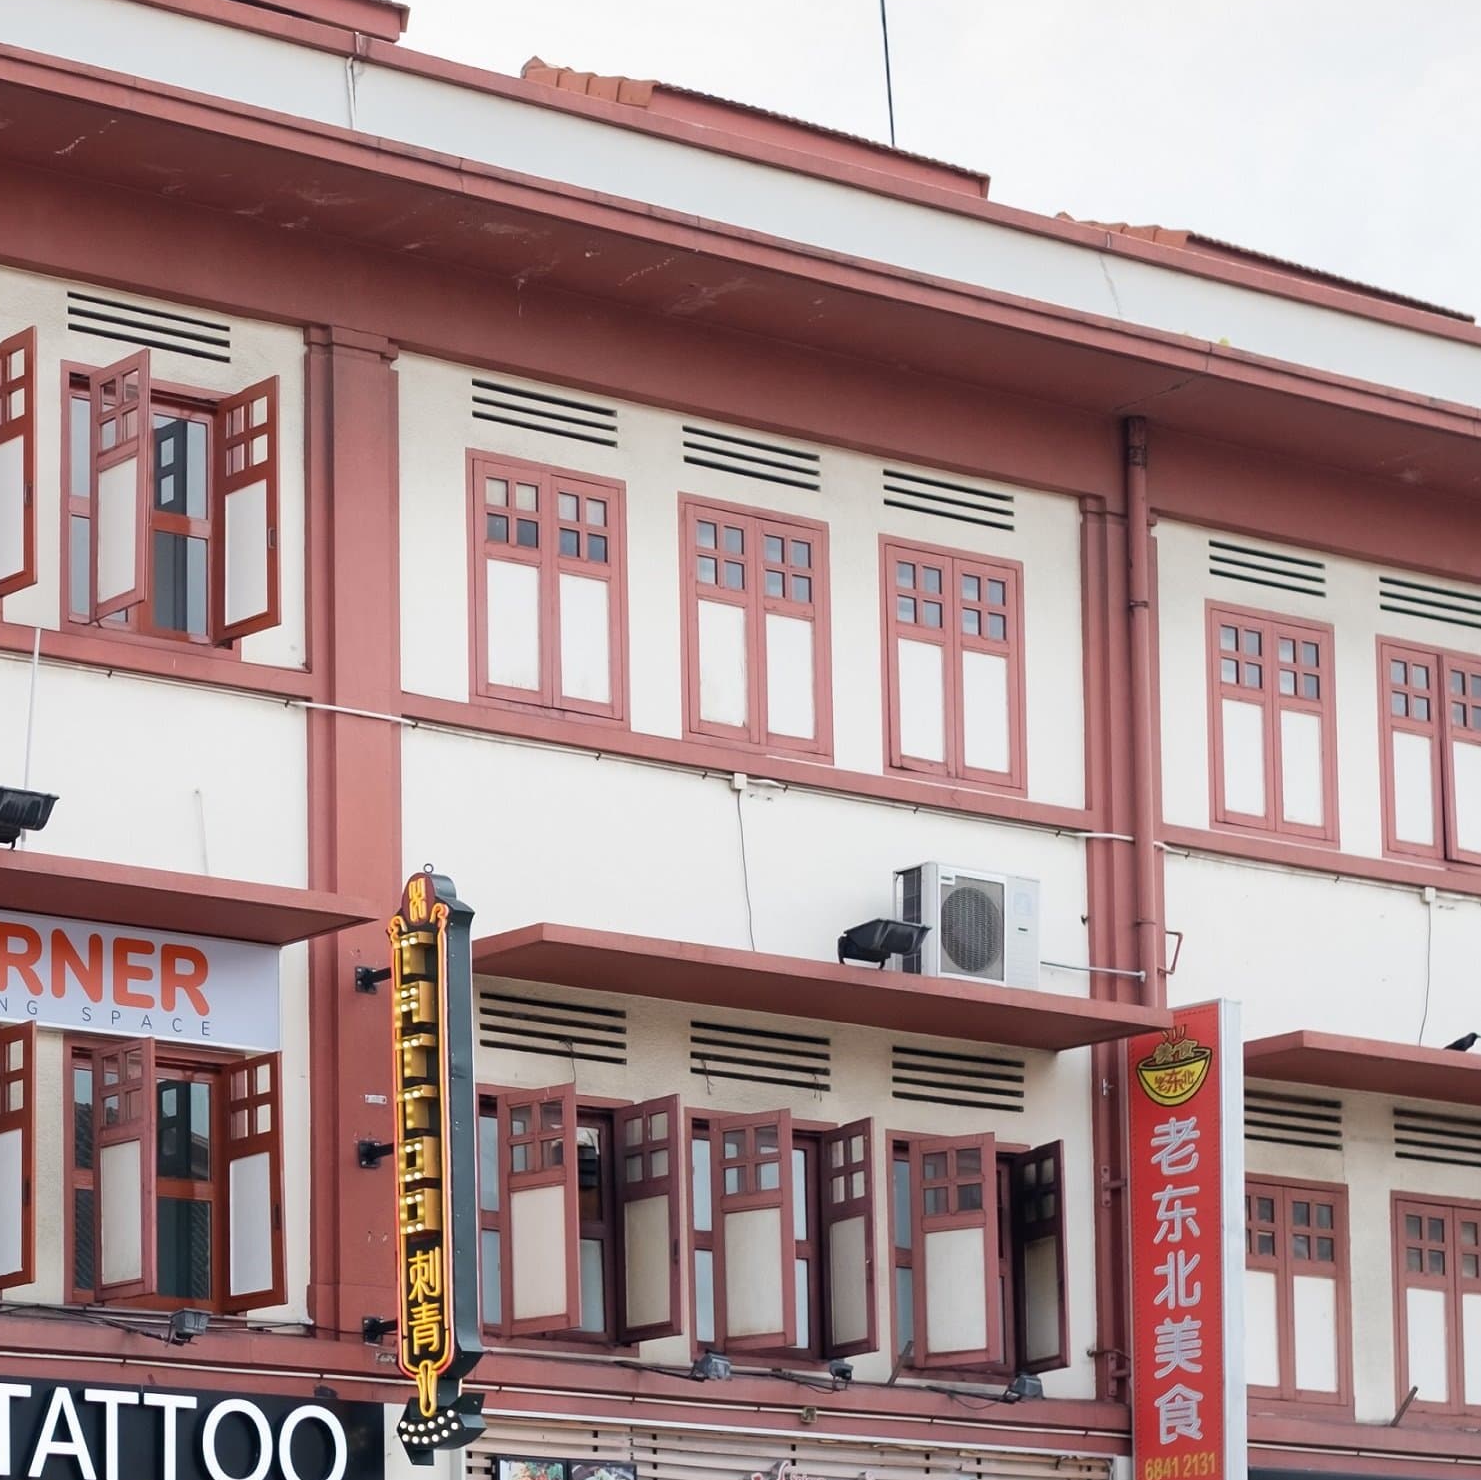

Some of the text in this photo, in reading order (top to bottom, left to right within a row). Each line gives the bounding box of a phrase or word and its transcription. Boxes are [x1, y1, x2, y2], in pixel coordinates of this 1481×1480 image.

[81, 1006, 211, 1037] SPACE
[407, 1246, 442, 1355] 刺青
[1150, 1116, 1204, 1446] 老东北美食
[1182, 1451, 1217, 1479] 2131
